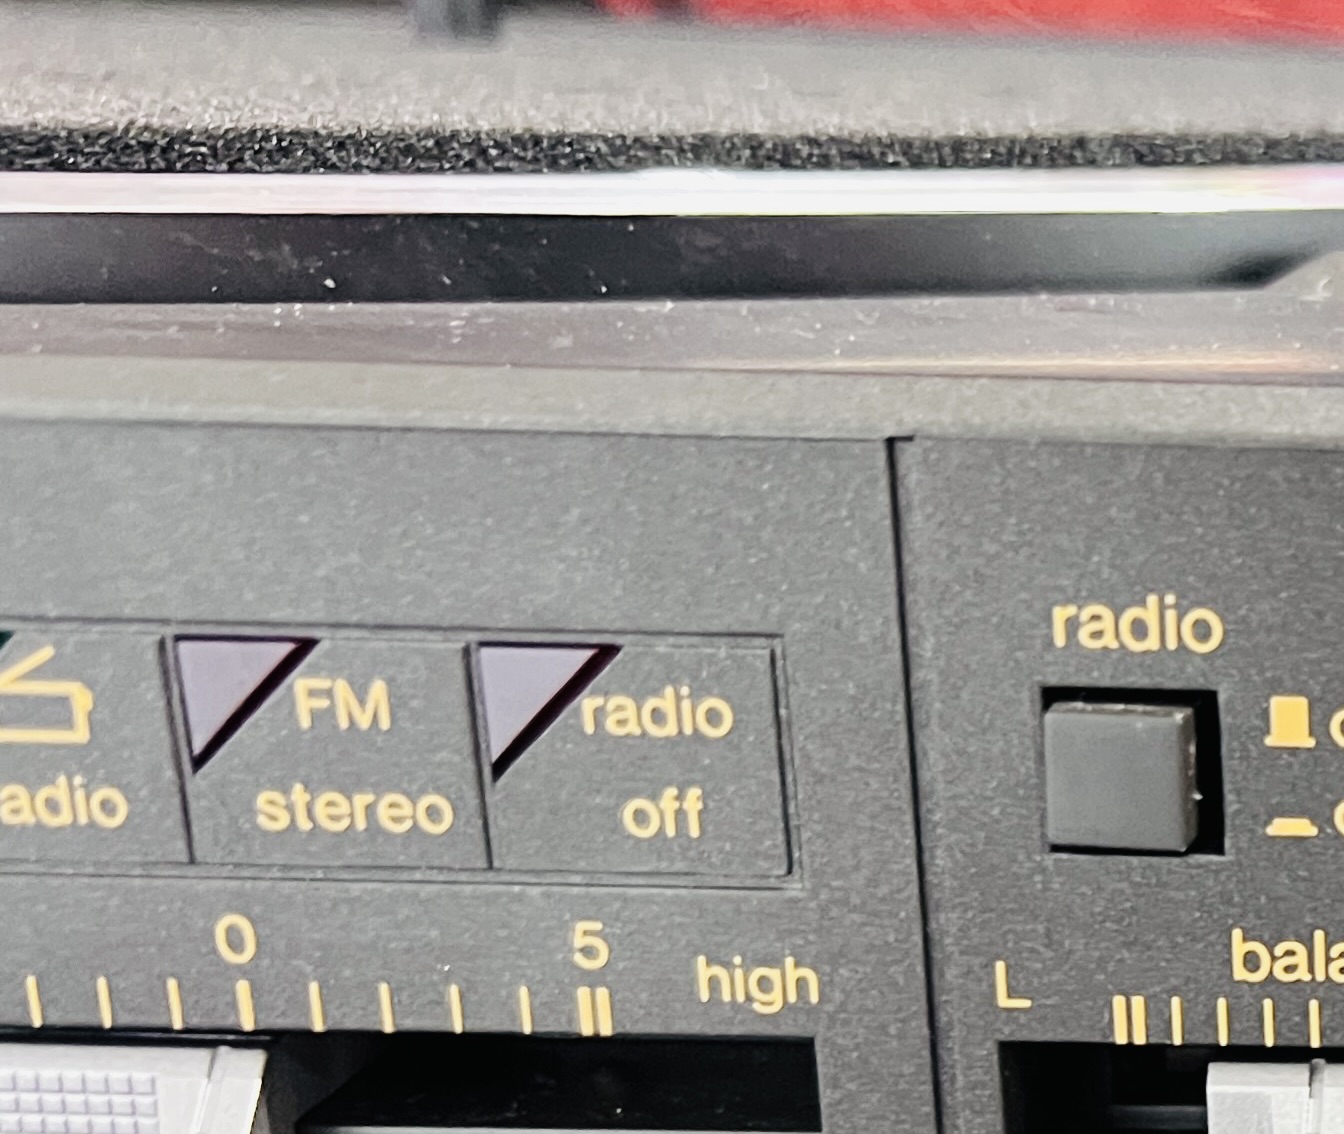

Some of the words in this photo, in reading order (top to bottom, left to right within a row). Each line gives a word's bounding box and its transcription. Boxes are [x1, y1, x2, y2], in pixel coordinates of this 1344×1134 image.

[1052, 594, 1224, 654] radio
[294, 678, 391, 730] FM
[582, 687, 733, 738] radio
[256, 784, 454, 835] stereo
[622, 786, 704, 838] off
[215, 914, 256, 964] 0
[573, 920, 610, 970] 5
[696, 954, 820, 1014] high
[995, 961, 1032, 1008] L
